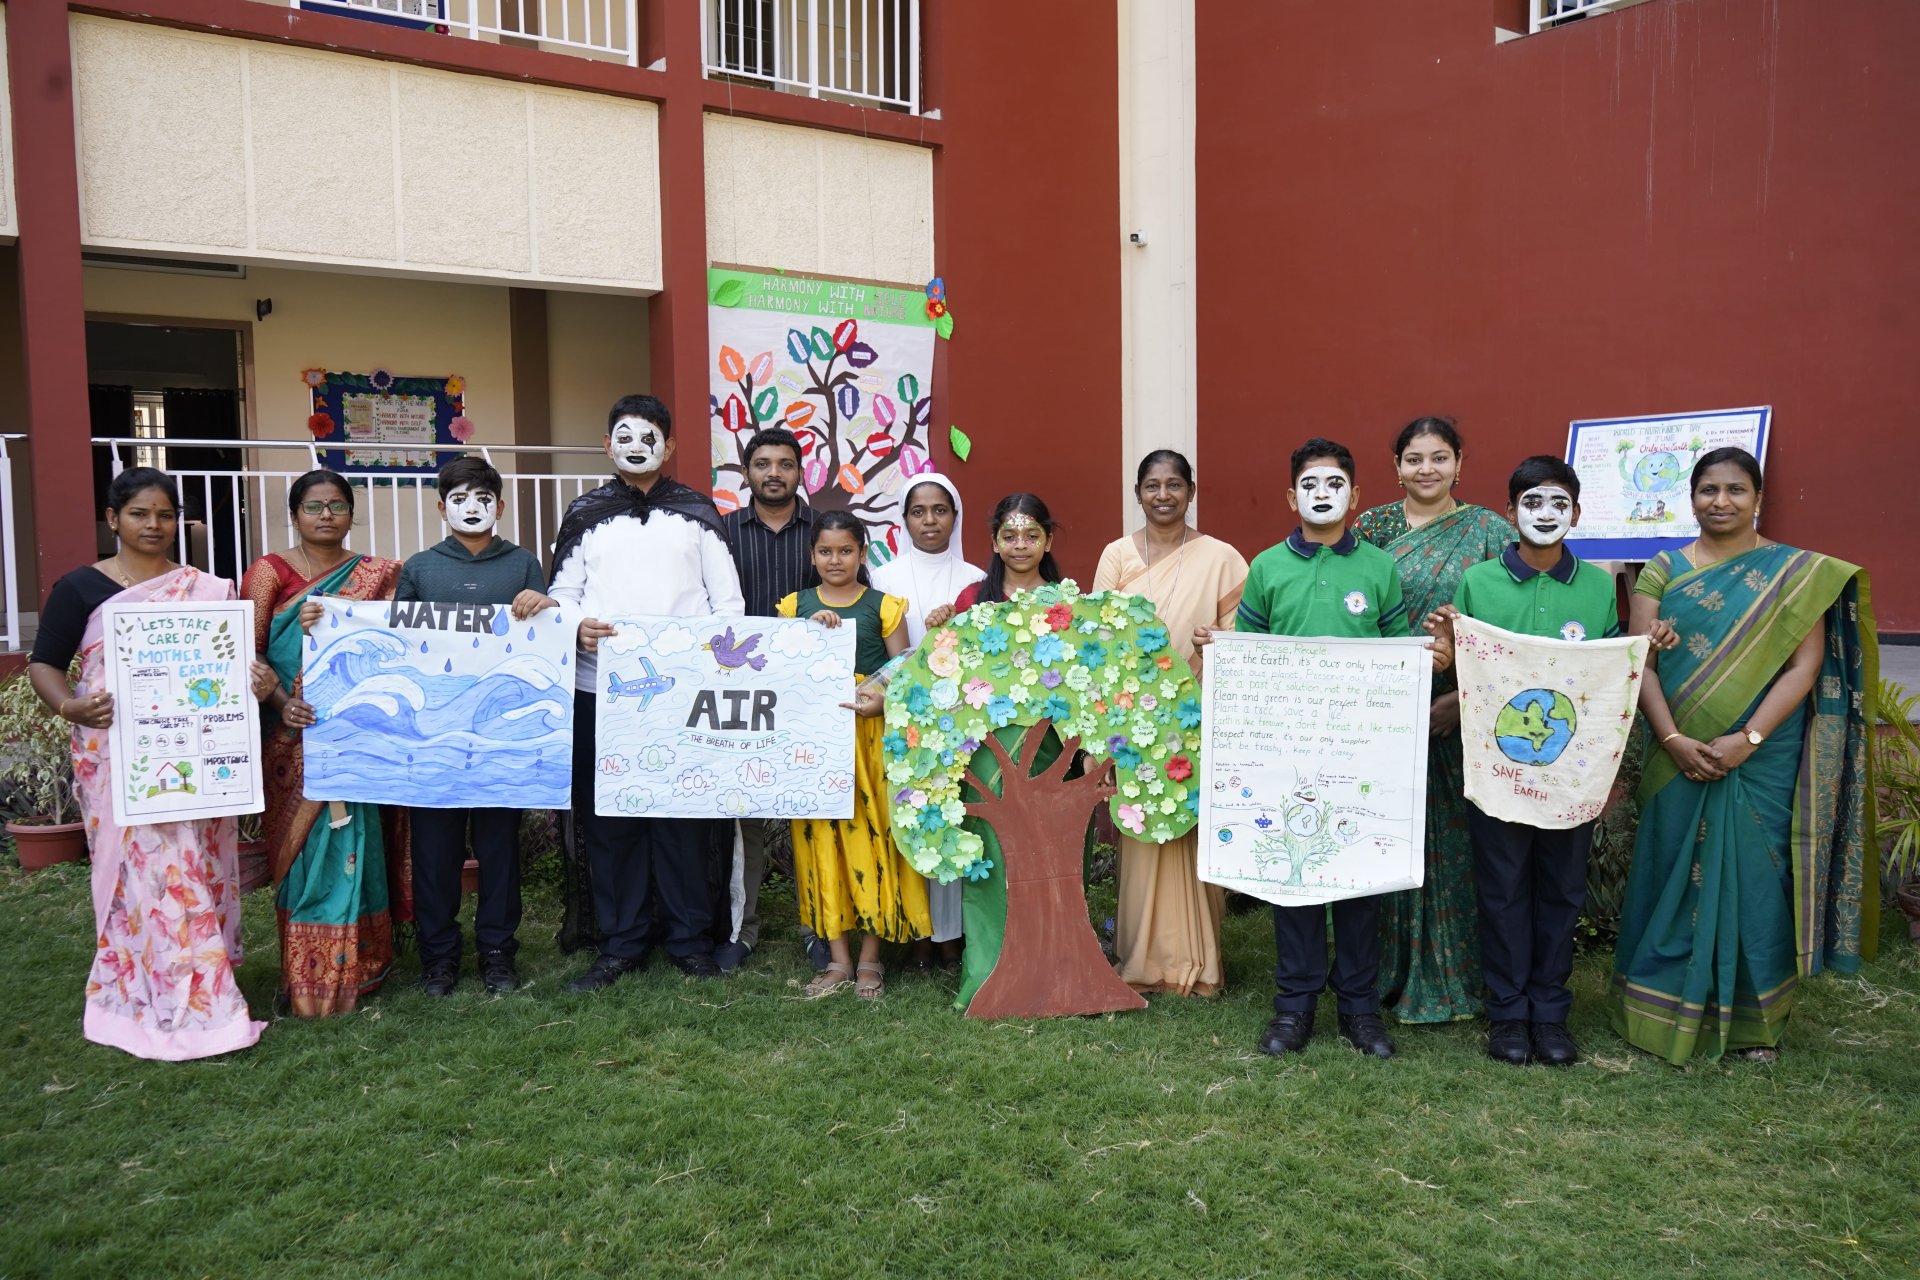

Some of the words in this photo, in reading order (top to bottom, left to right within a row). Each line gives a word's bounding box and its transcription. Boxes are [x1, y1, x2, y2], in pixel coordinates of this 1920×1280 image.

[763, 277, 823, 295] HARMONY
[830, 285, 865, 301] WITH
[874, 291, 905, 306] SELF
[749, 295, 810, 312] HARMONY
[818, 300, 854, 315] WITH
[864, 304, 905, 320] NATURE
[1613, 429, 1636, 437] WORLD
[1640, 443, 1659, 454] Only
[141, 617, 174, 631] LET'S
[178, 617, 212, 631] TAKE
[389, 601, 496, 634] WATER
[147, 633, 180, 645] CARE
[184, 633, 200, 644] OF
[138, 649, 202, 664] MOTHER
[1215, 652, 1236, 664] Save
[1243, 650, 1257, 664] the
[1298, 656, 1311, 666] it's
[1319, 659, 1341, 668] our
[1346, 659, 1365, 672] only
[179, 661, 230, 678] EARTH!
[1214, 677, 1229, 688] Be
[1236, 680, 1244, 688] a
[1249, 679, 1268, 692] part
[1272, 680, 1282, 691] of
[1325, 684, 1341, 694] not
[1346, 684, 1360, 695] the
[1213, 688, 1238, 701] Clean
[1241, 690, 1259, 702] and
[1264, 694, 1289, 705] green
[1294, 694, 1302, 703] is
[1307, 697, 1324, 705] our
[1328, 698, 1358, 711] perfect
[203, 712, 245, 723] PROBLEMS
[685, 690, 778, 731] AIR
[1213, 701, 1239, 713] Plant
[1243, 705, 1250, 713] a
[1283, 706, 1304, 717] save
[1311, 709, 1318, 718] a
[1212, 725, 1245, 741] Respect
[1319, 735, 1334, 746] only
[1325, 721, 1351, 732] treat
[1357, 722, 1364, 732] it
[1370, 721, 1383, 733] like
[691, 734, 703, 743] THE
[706, 737, 734, 748] BREATH
[740, 741, 752, 750] OF
[756, 736, 777, 750] LIFE
[1239, 740, 1249, 750] be
[1293, 745, 1311, 757] keep
[1318, 747, 1324, 755] it
[203, 755, 249, 765] IMPORTANCE
[794, 748, 815, 764] He
[745, 762, 770, 783] Ne
[1298, 776, 1308, 785] GO
[1491, 762, 1524, 784] SAVE
[828, 776, 848, 790] Xe
[625, 793, 643, 808] Kr
[1514, 784, 1548, 801] EARTH
